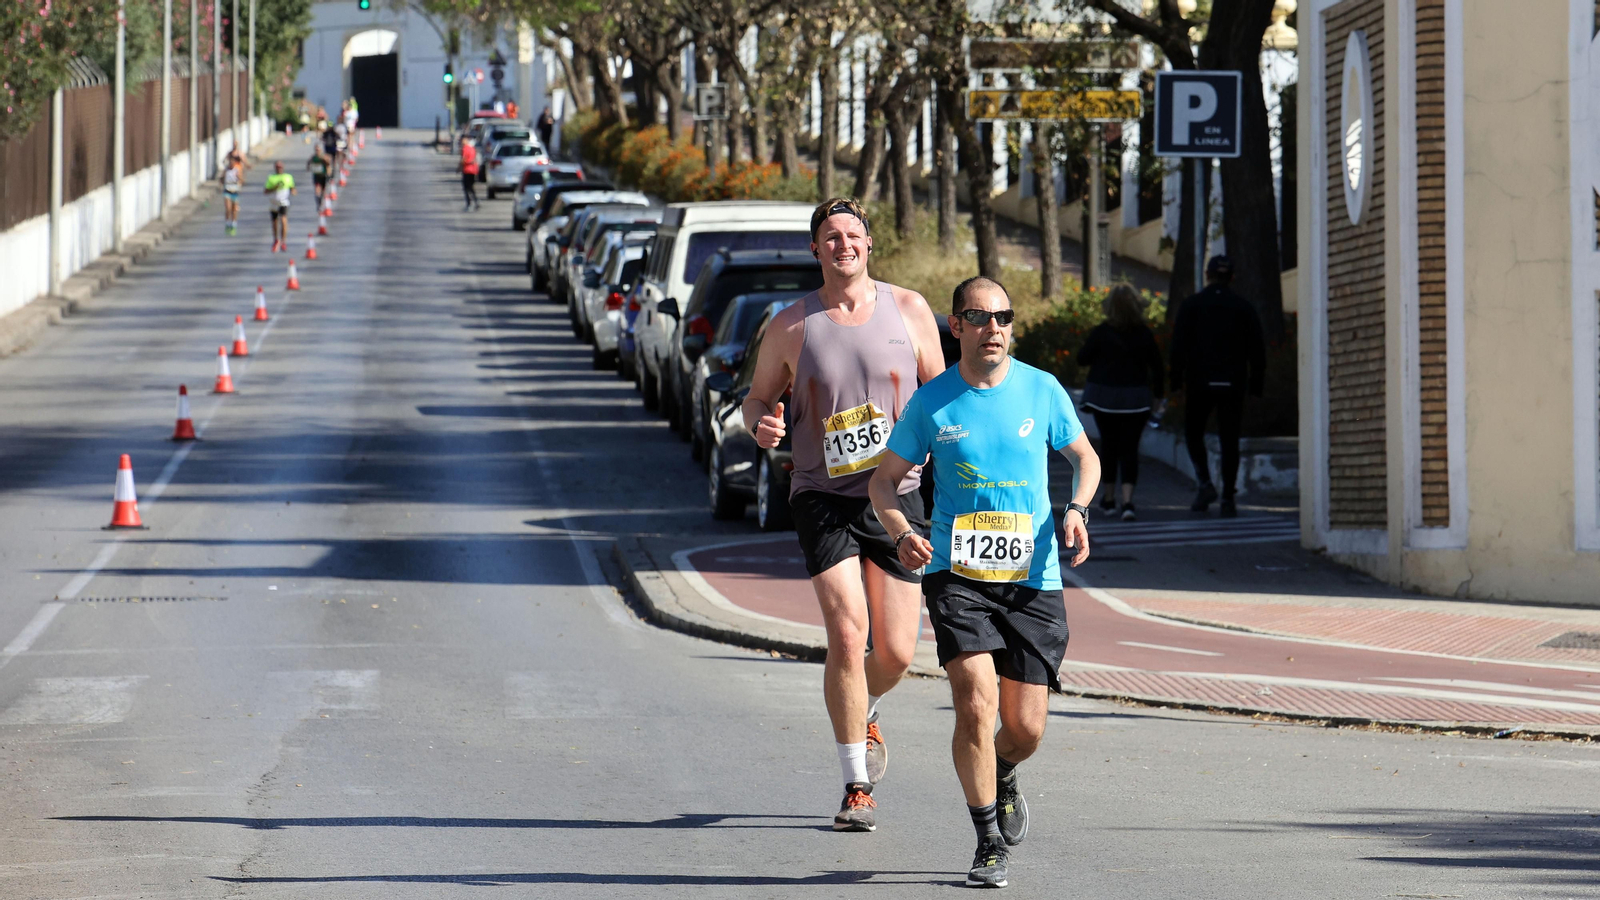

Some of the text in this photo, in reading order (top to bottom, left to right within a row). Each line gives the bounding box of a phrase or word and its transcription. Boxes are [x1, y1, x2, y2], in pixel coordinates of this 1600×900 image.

[699, 88, 721, 116] P
[1171, 81, 1218, 146] P
[1204, 126, 1221, 134] EN
[1194, 137, 1231, 146] LINEA
[834, 408, 868, 425] Sherry
[832, 424, 882, 456] 1356
[962, 481, 996, 489] MOVE
[997, 480, 1028, 488] OSLO
[977, 512, 1014, 528] Sherry
[989, 523, 1009, 531] Media
[966, 534, 1022, 561] 1286
